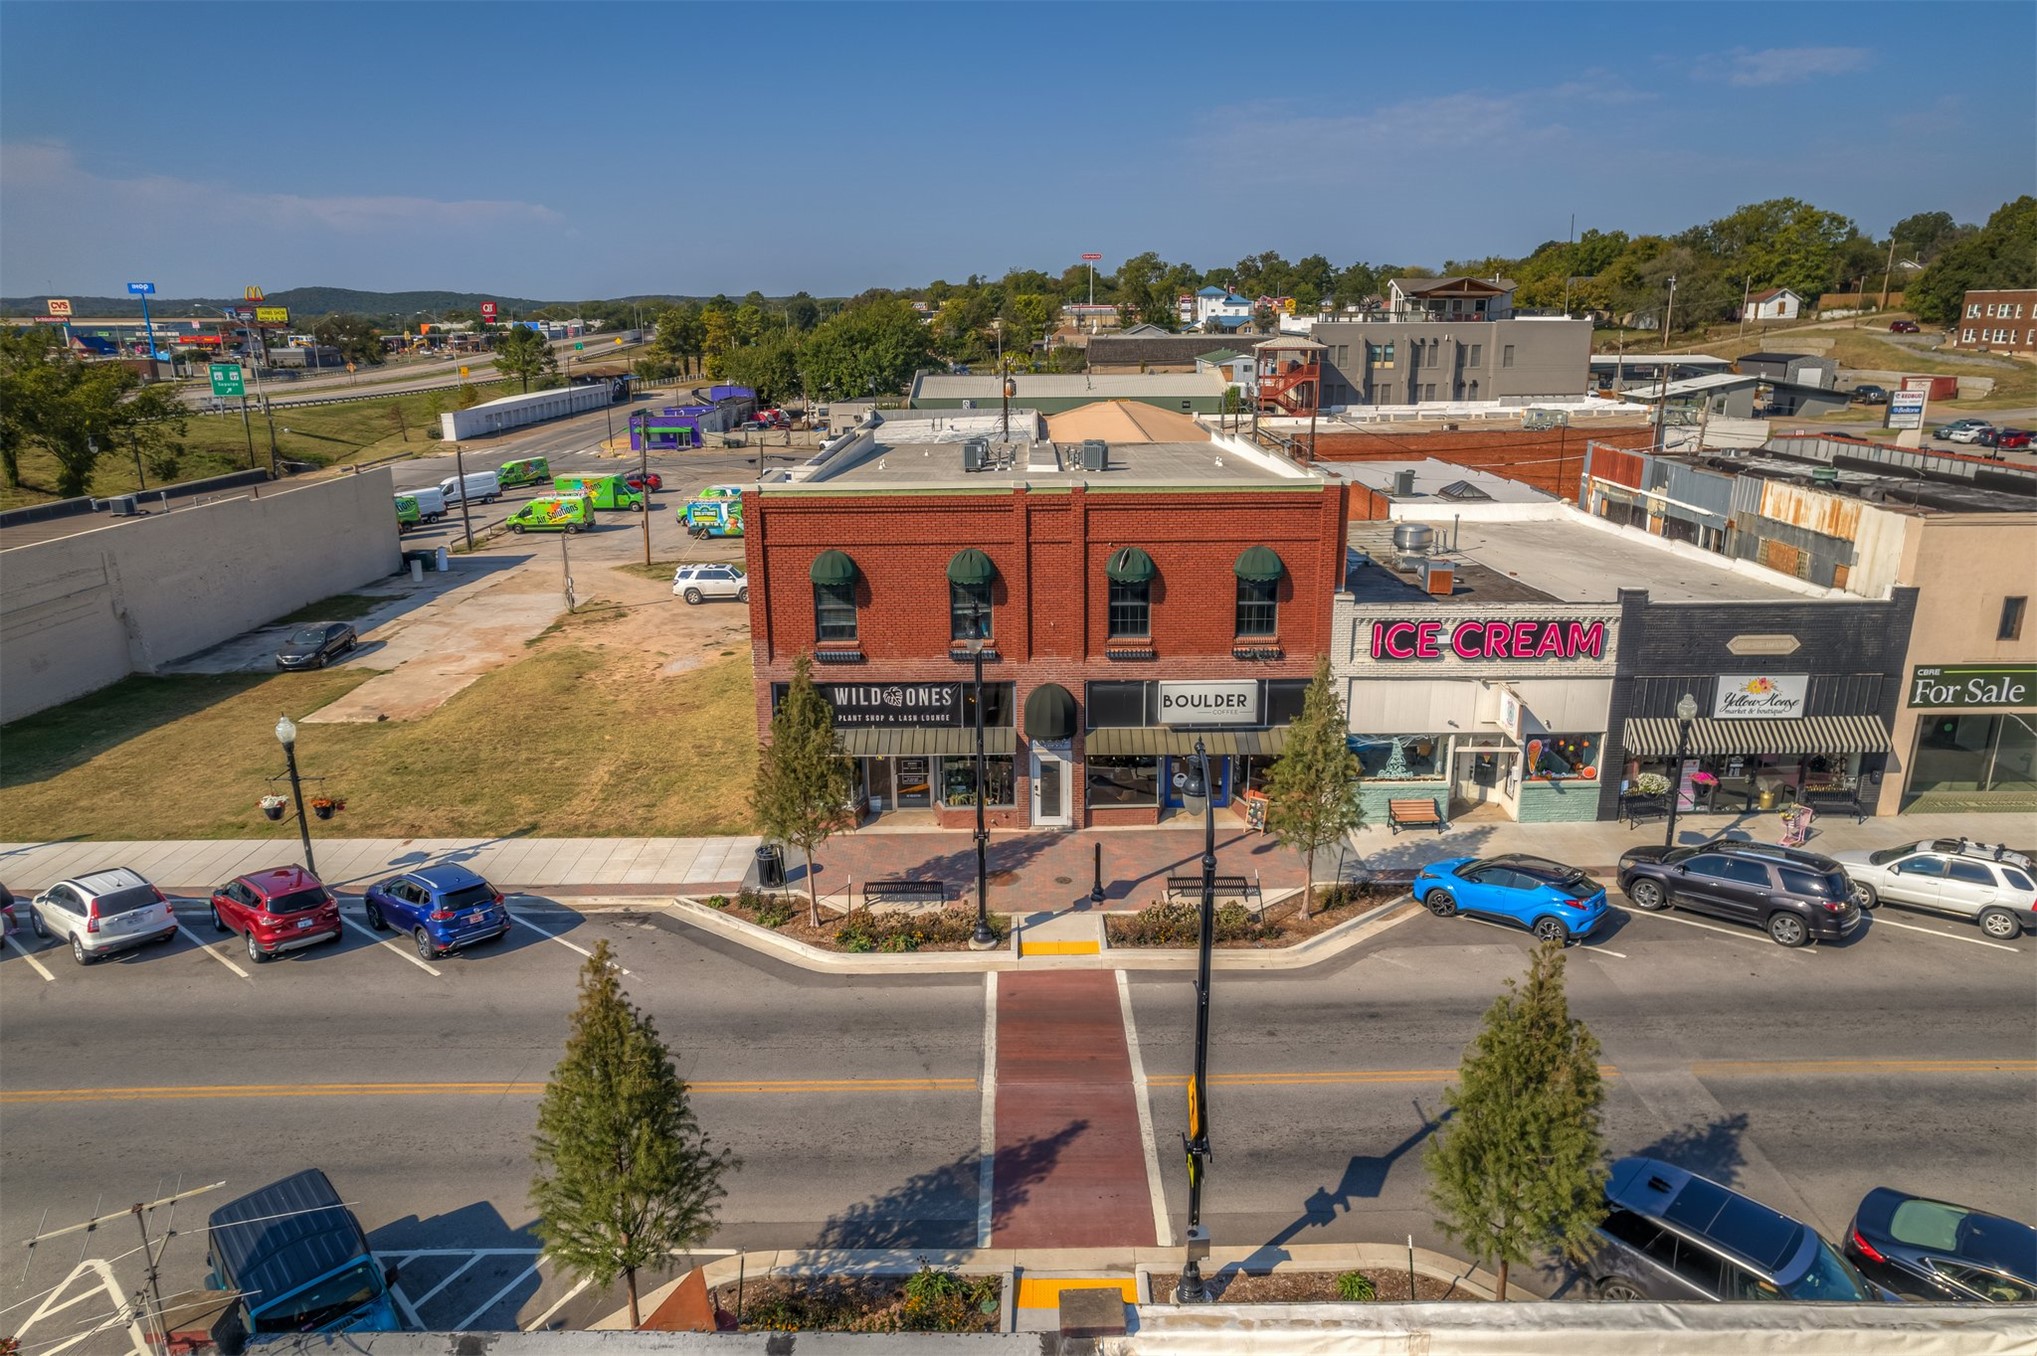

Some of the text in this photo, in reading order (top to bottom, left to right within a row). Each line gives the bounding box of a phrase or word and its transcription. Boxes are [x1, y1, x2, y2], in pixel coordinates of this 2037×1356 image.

[50, 301, 68, 309] CVS
[482, 303, 493, 312] QT
[536, 515, 546, 524] Air
[546, 504, 579, 521] Solutions
[1372, 621, 1605, 659] ICE CREAM
[1917, 668, 1941, 676] CBRE
[834, 687, 952, 706] WILD ONES
[1912, 676, 2026, 704] For Sale
[1163, 693, 1247, 708] BOULDER
[1719, 692, 1800, 712] Yellow House
[1756, 707, 1784, 716] boutique
